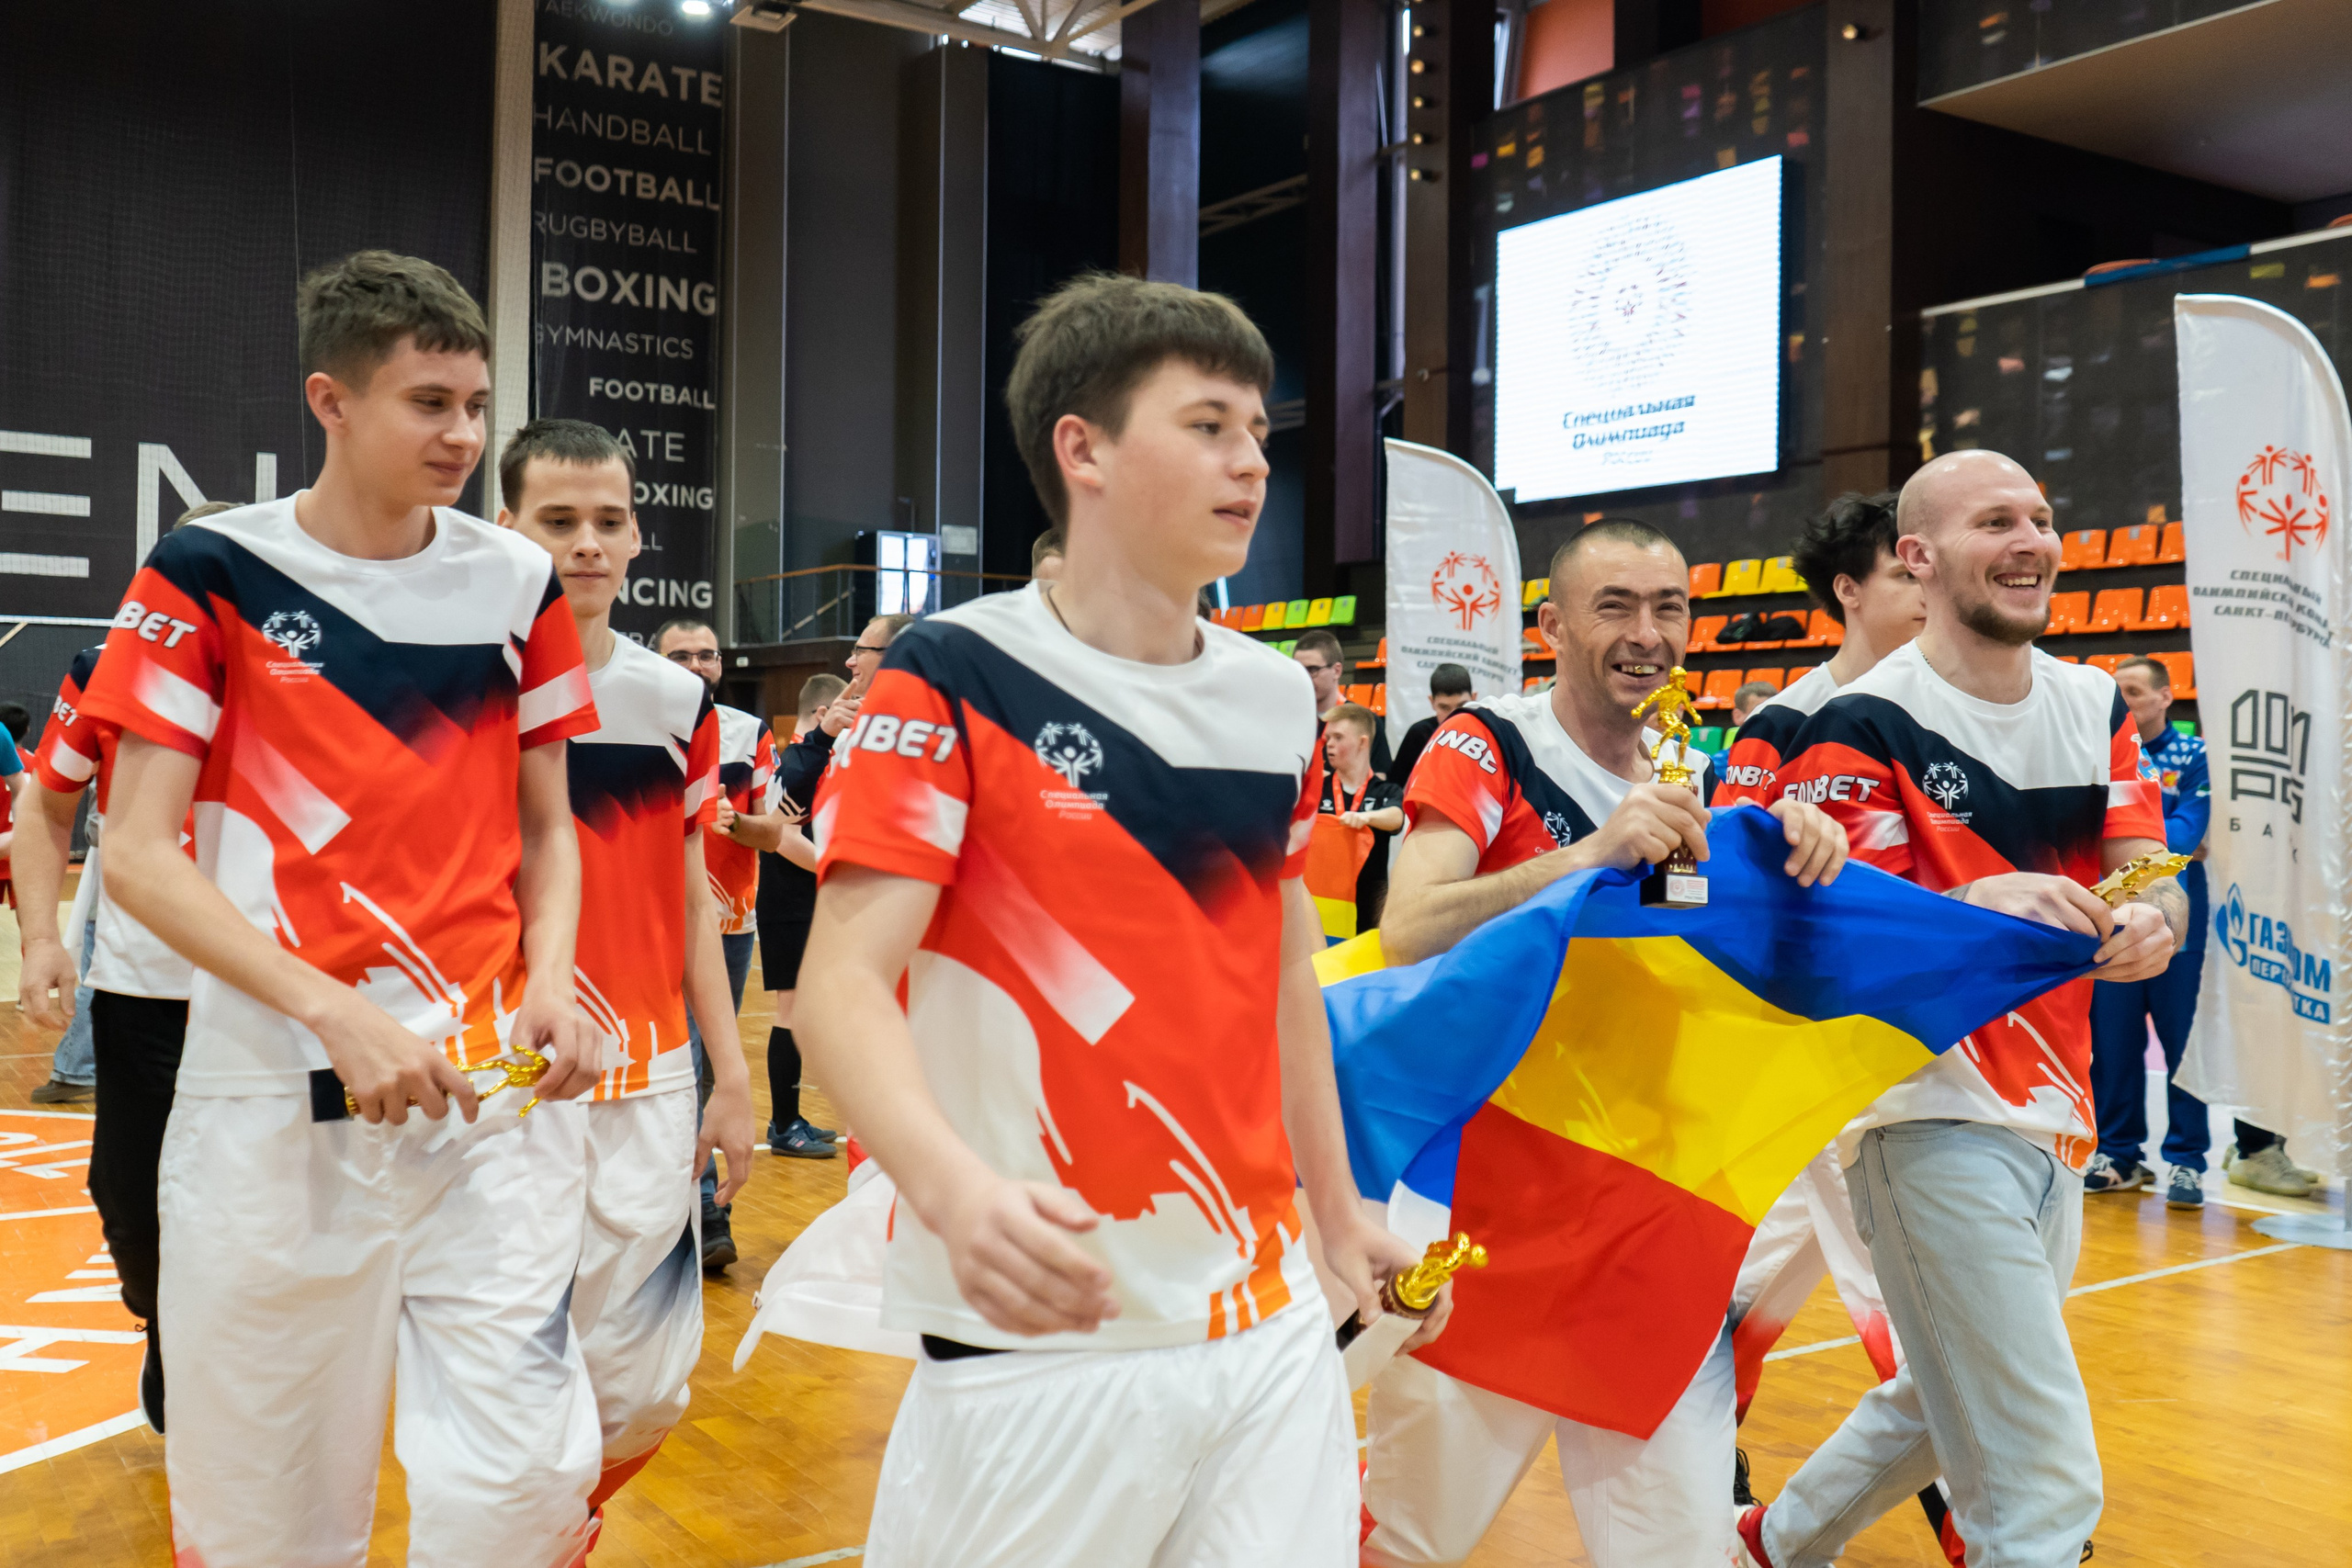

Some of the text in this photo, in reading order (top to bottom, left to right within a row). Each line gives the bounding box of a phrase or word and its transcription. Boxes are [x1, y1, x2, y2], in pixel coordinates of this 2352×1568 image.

[538, 41, 723, 108] KARATE
[533, 102, 712, 156] HANDBALL
[533, 156, 720, 211] FOOTBALL
[541, 261, 717, 317] BOXING
[589, 377, 716, 411] FOOTBALL
[2192, 585, 2295, 609] ОЛИМПИЙСК
[111, 600, 198, 649] BET
